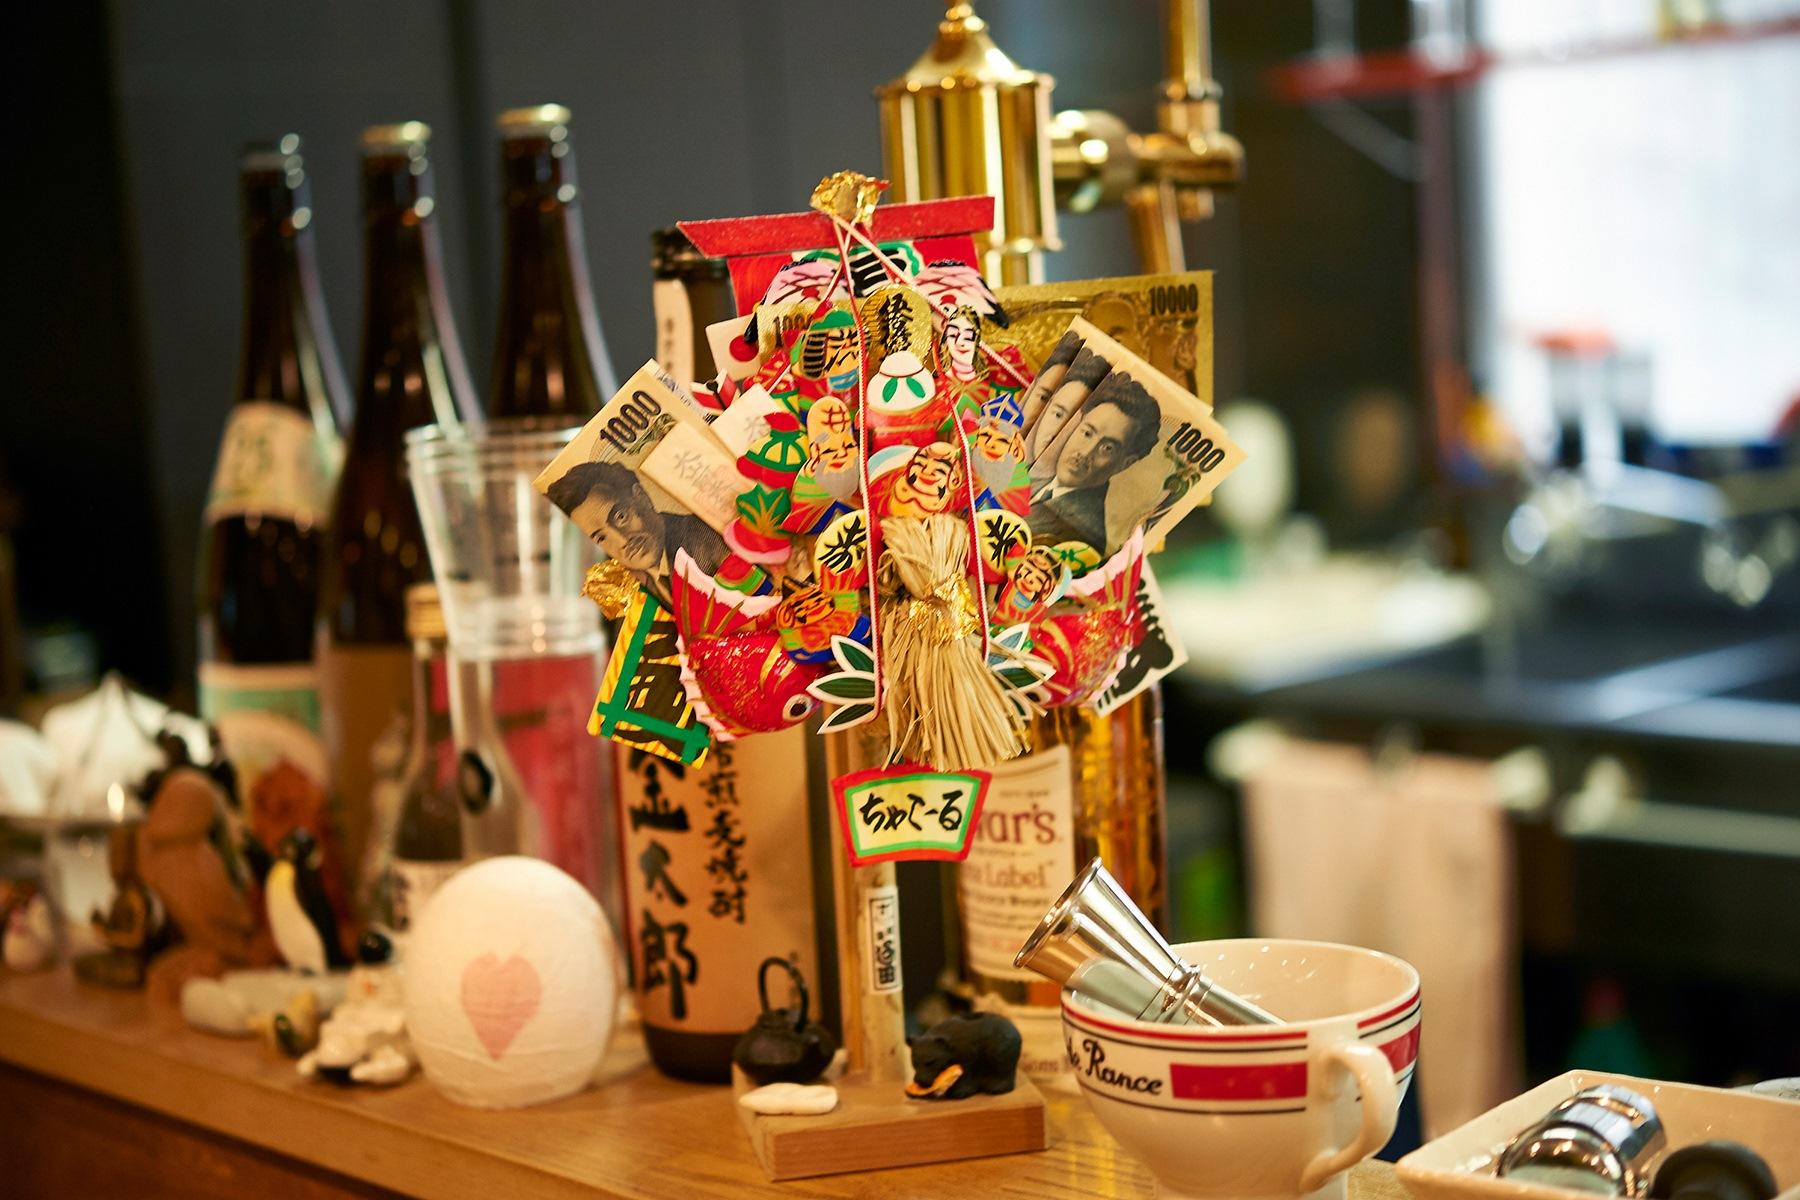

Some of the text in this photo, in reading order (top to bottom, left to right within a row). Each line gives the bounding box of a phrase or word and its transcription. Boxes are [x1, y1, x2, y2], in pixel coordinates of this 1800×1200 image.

[1150, 283, 1199, 315] 10000
[599, 390, 662, 453] 1000
[1167, 421, 1225, 473] 1000
[1083, 1038, 1163, 1095] Rance
